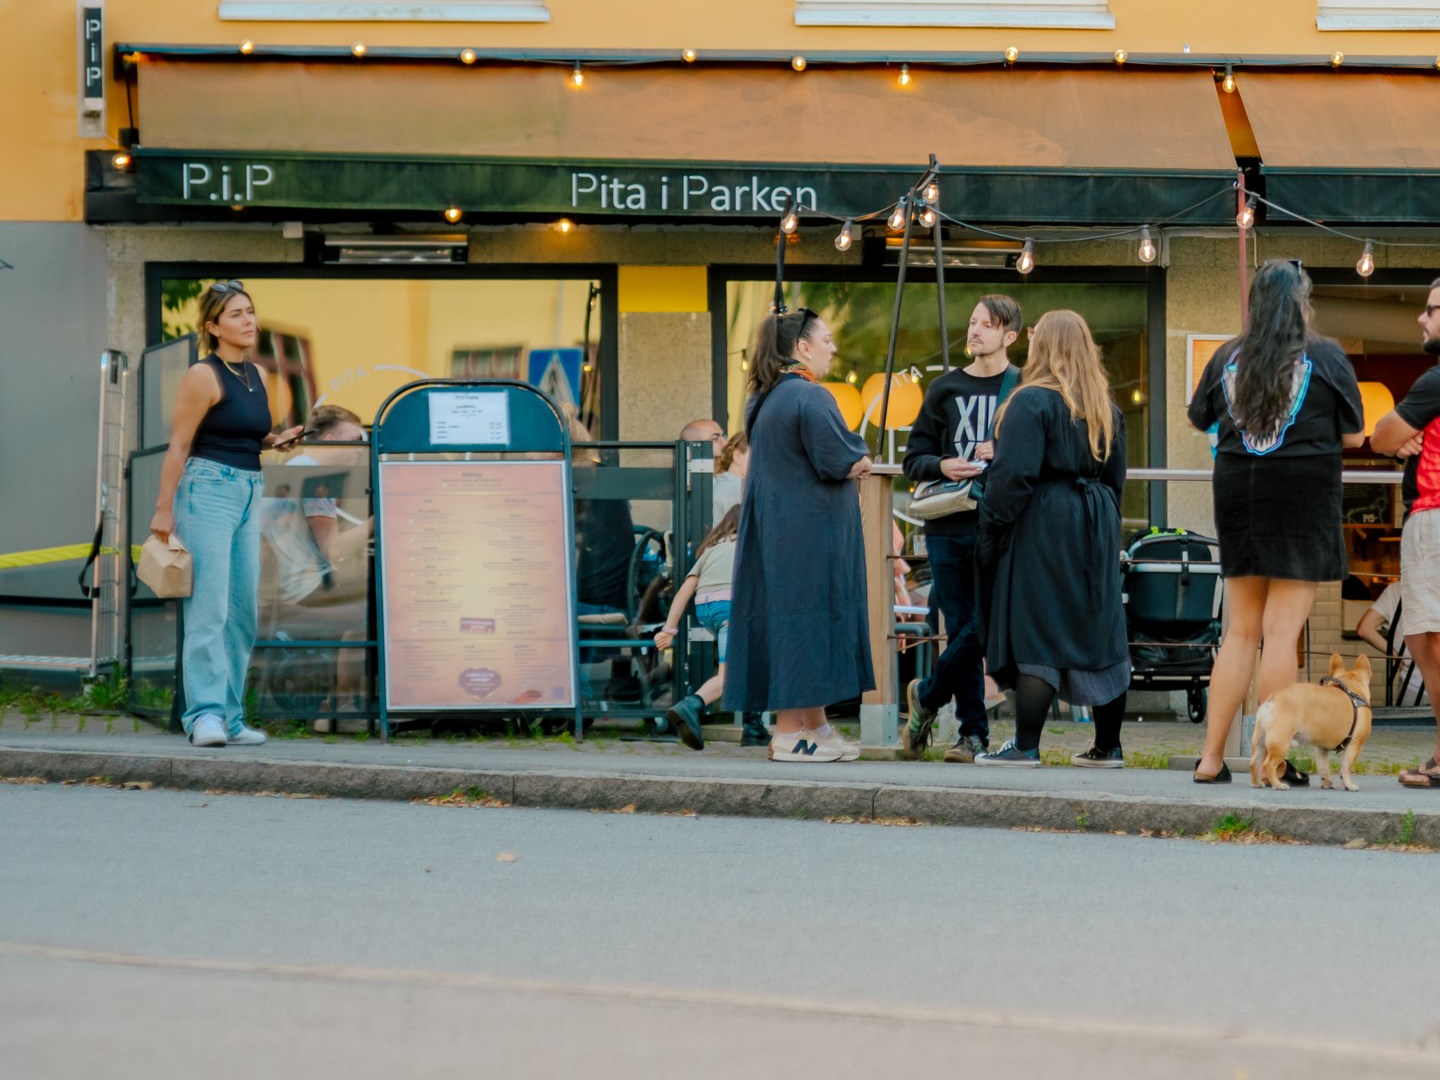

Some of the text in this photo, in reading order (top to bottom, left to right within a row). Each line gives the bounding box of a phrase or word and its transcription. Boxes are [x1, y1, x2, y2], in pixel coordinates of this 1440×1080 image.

[183, 163, 274, 201] P.i.P
[572, 172, 818, 212] Pita i Parken
[328, 364, 369, 393] PITA
